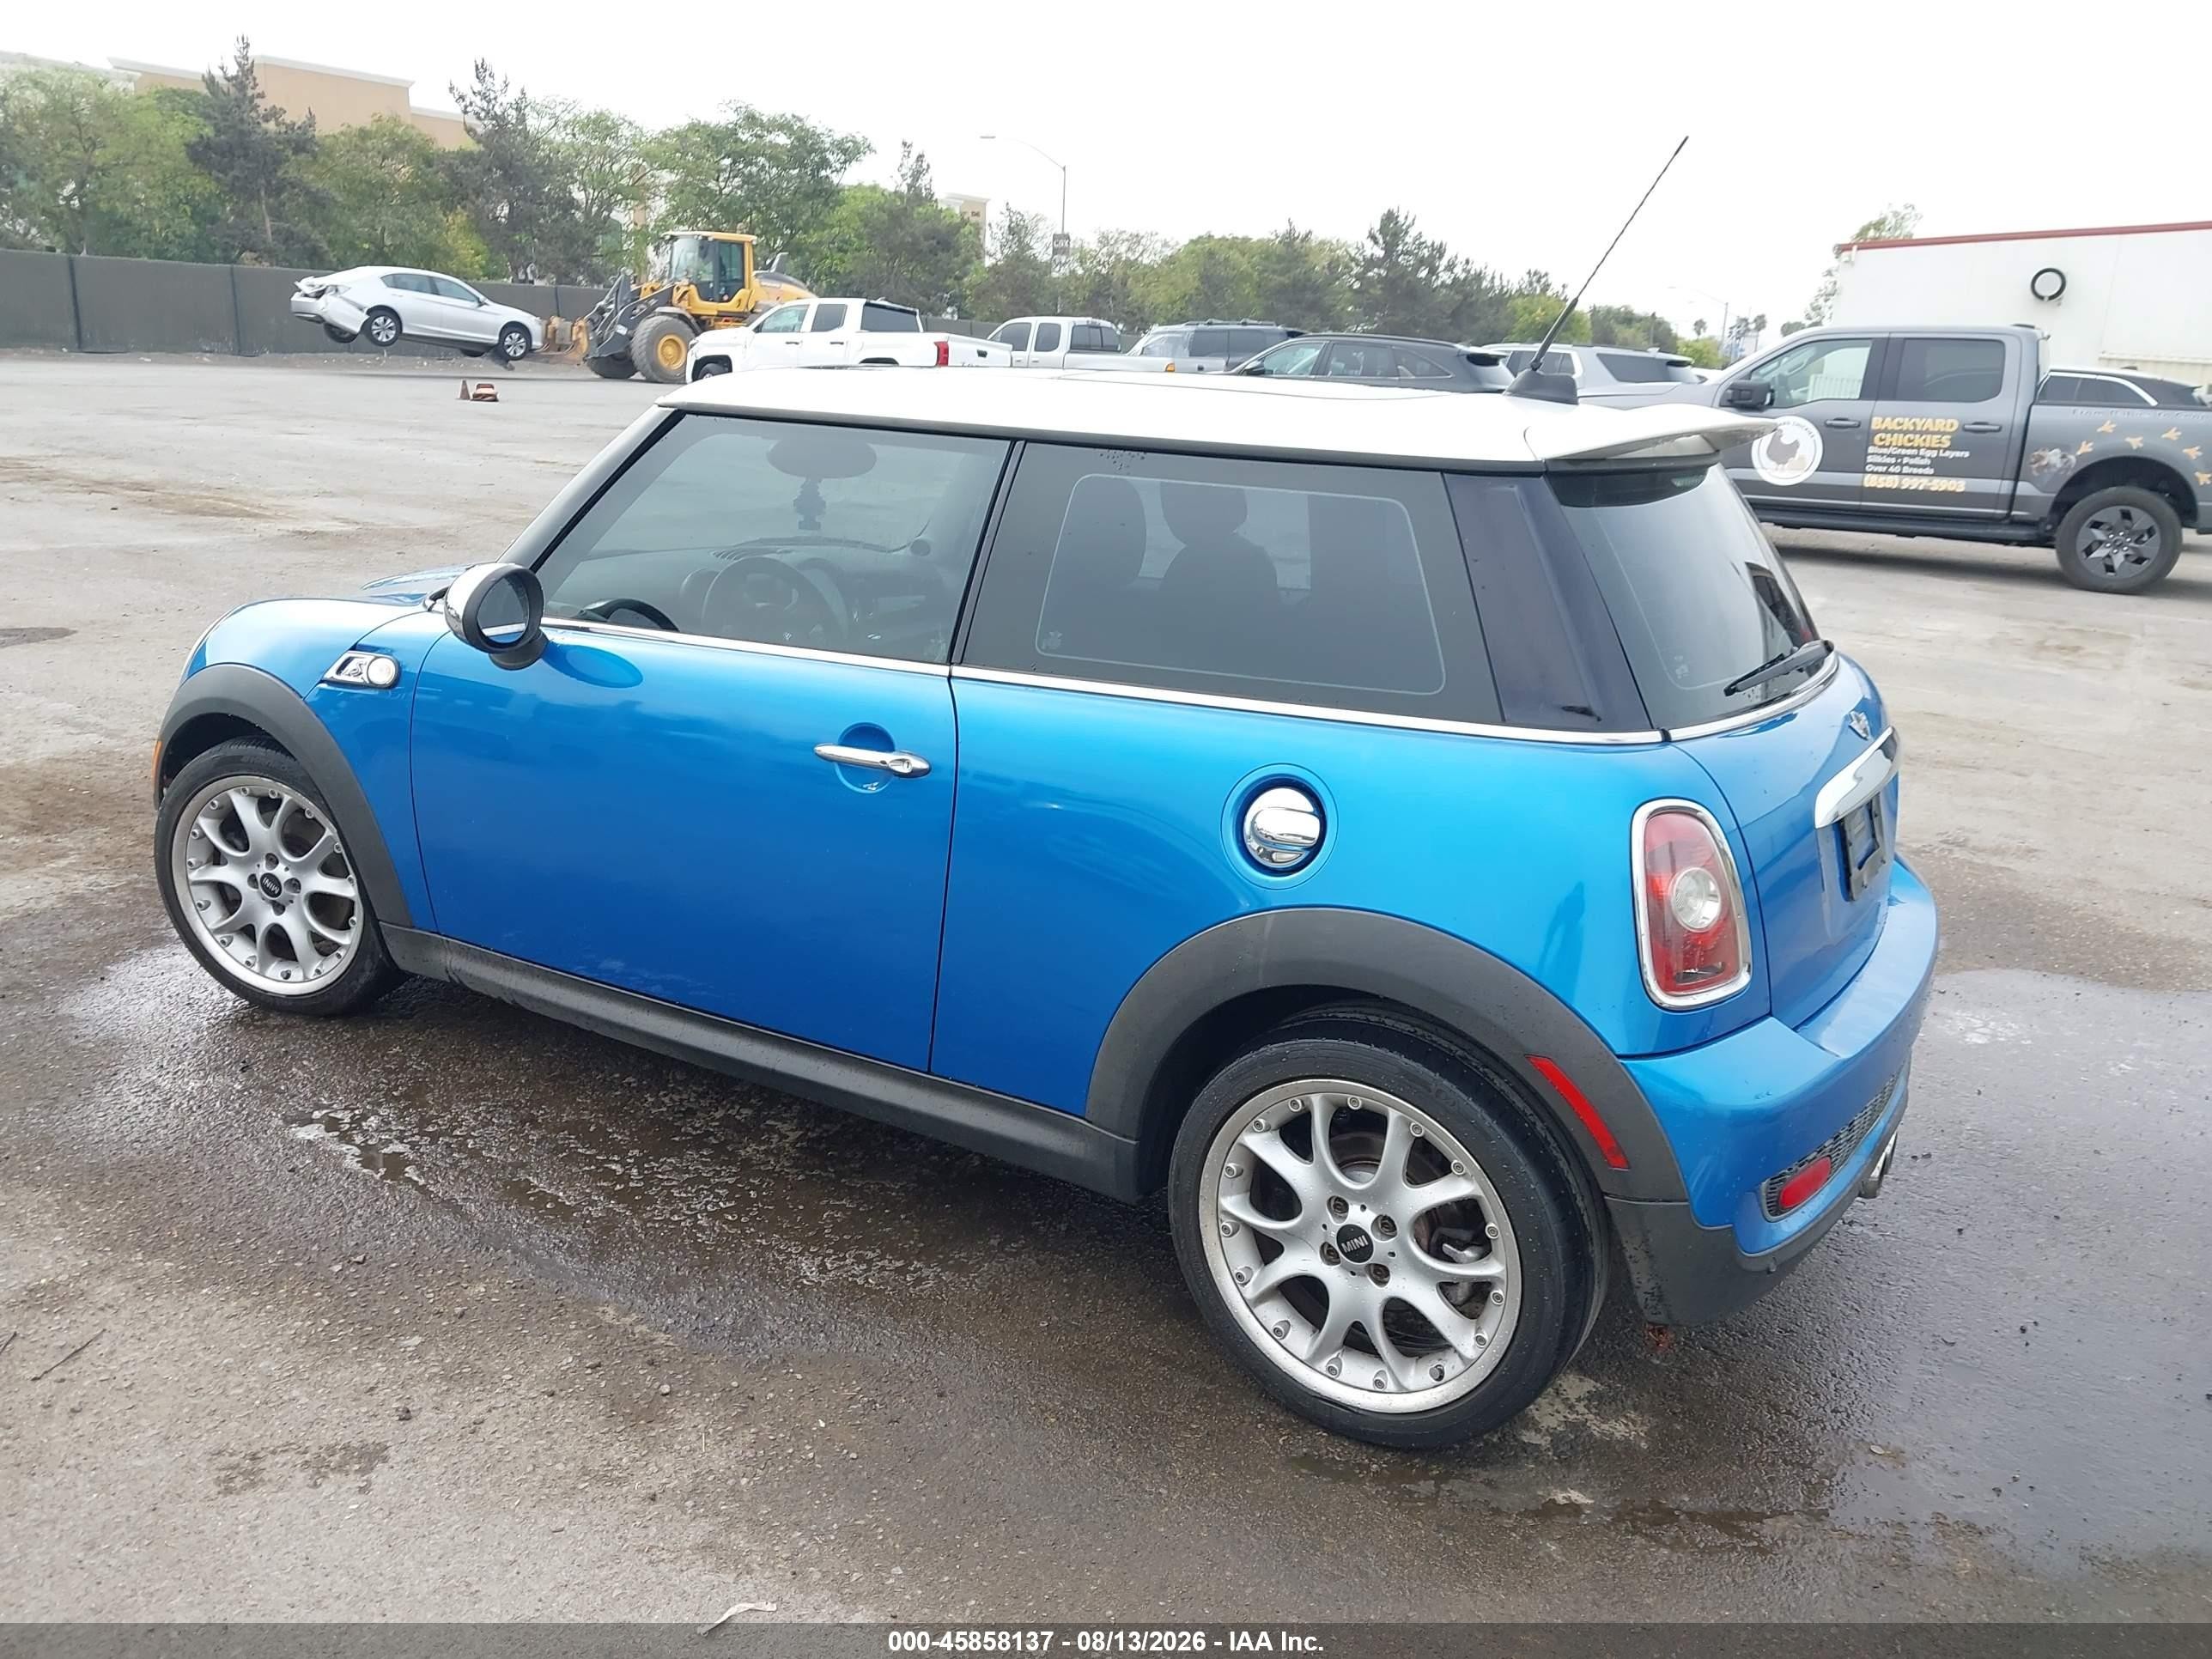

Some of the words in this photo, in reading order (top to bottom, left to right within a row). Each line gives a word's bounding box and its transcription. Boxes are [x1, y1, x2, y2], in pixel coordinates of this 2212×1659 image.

[1871, 416, 1959, 432] BACKYARD
[1874, 433, 1952, 447] CHICKIES
[1919, 448, 1938, 458] Egg
[1939, 450, 1970, 459] Layers
[1865, 464, 1887, 472] Over
[1341, 1235, 1369, 1254] MINI
